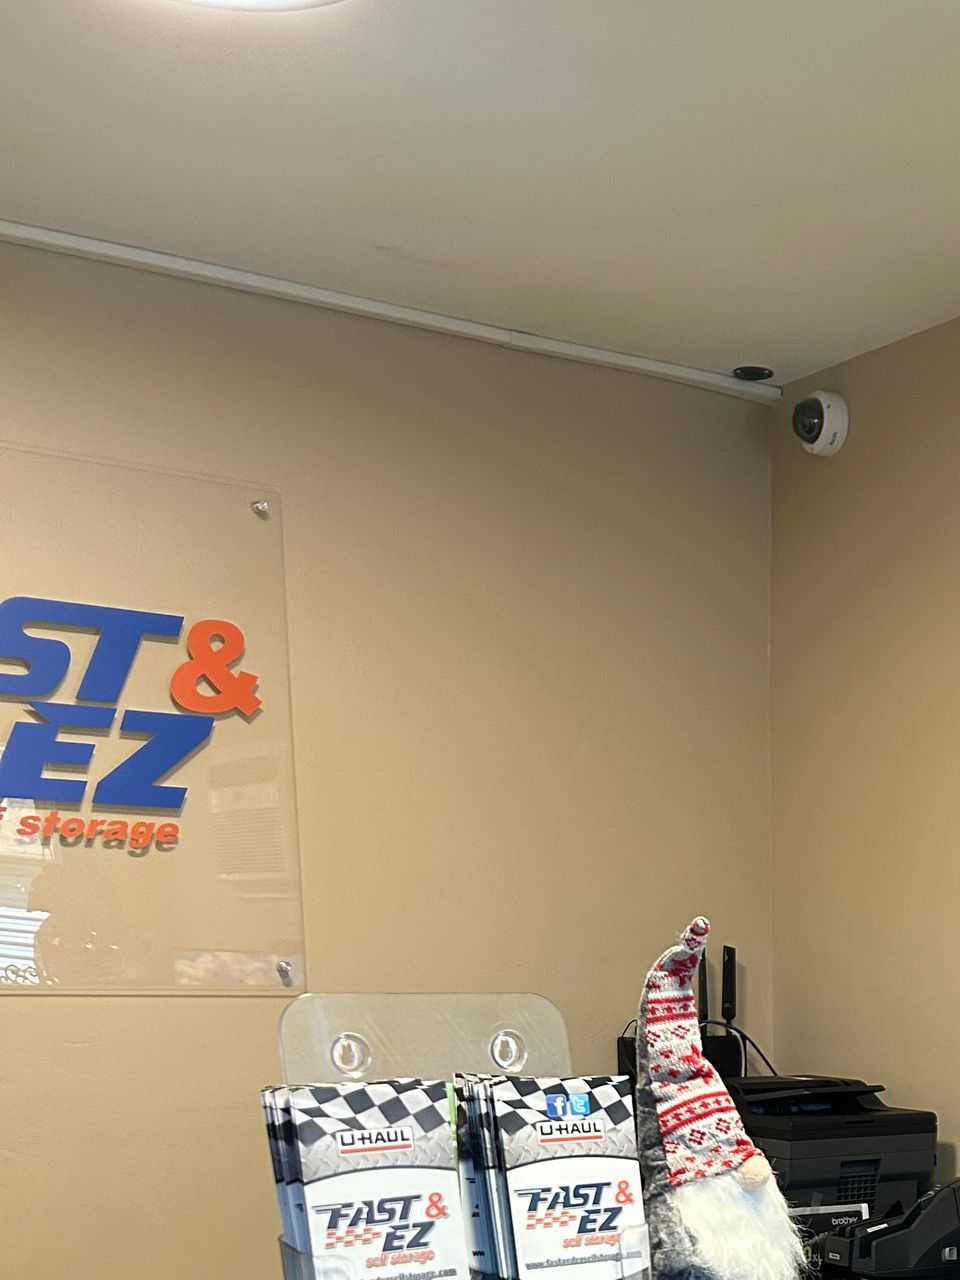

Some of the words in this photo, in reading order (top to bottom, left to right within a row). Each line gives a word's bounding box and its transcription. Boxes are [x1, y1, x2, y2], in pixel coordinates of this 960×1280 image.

[171, 619, 262, 716] &
[0, 701, 215, 809] EZ
[16, 809, 179, 849] storage
[340, 1130, 410, 1147] U-HAUL
[540, 1121, 602, 1136] U-HAUL
[311, 1194, 423, 1230] FAST
[425, 1192, 450, 1219] &
[514, 1182, 612, 1212] FAST
[615, 1180, 635, 1205] &
[577, 1206, 623, 1235] EZ
[831, 1216, 858, 1226] brother
[382, 1221, 436, 1253] EZ
[562, 1235, 583, 1249] self
[366, 1254, 388, 1269] self
[390, 1249, 436, 1266] storage
